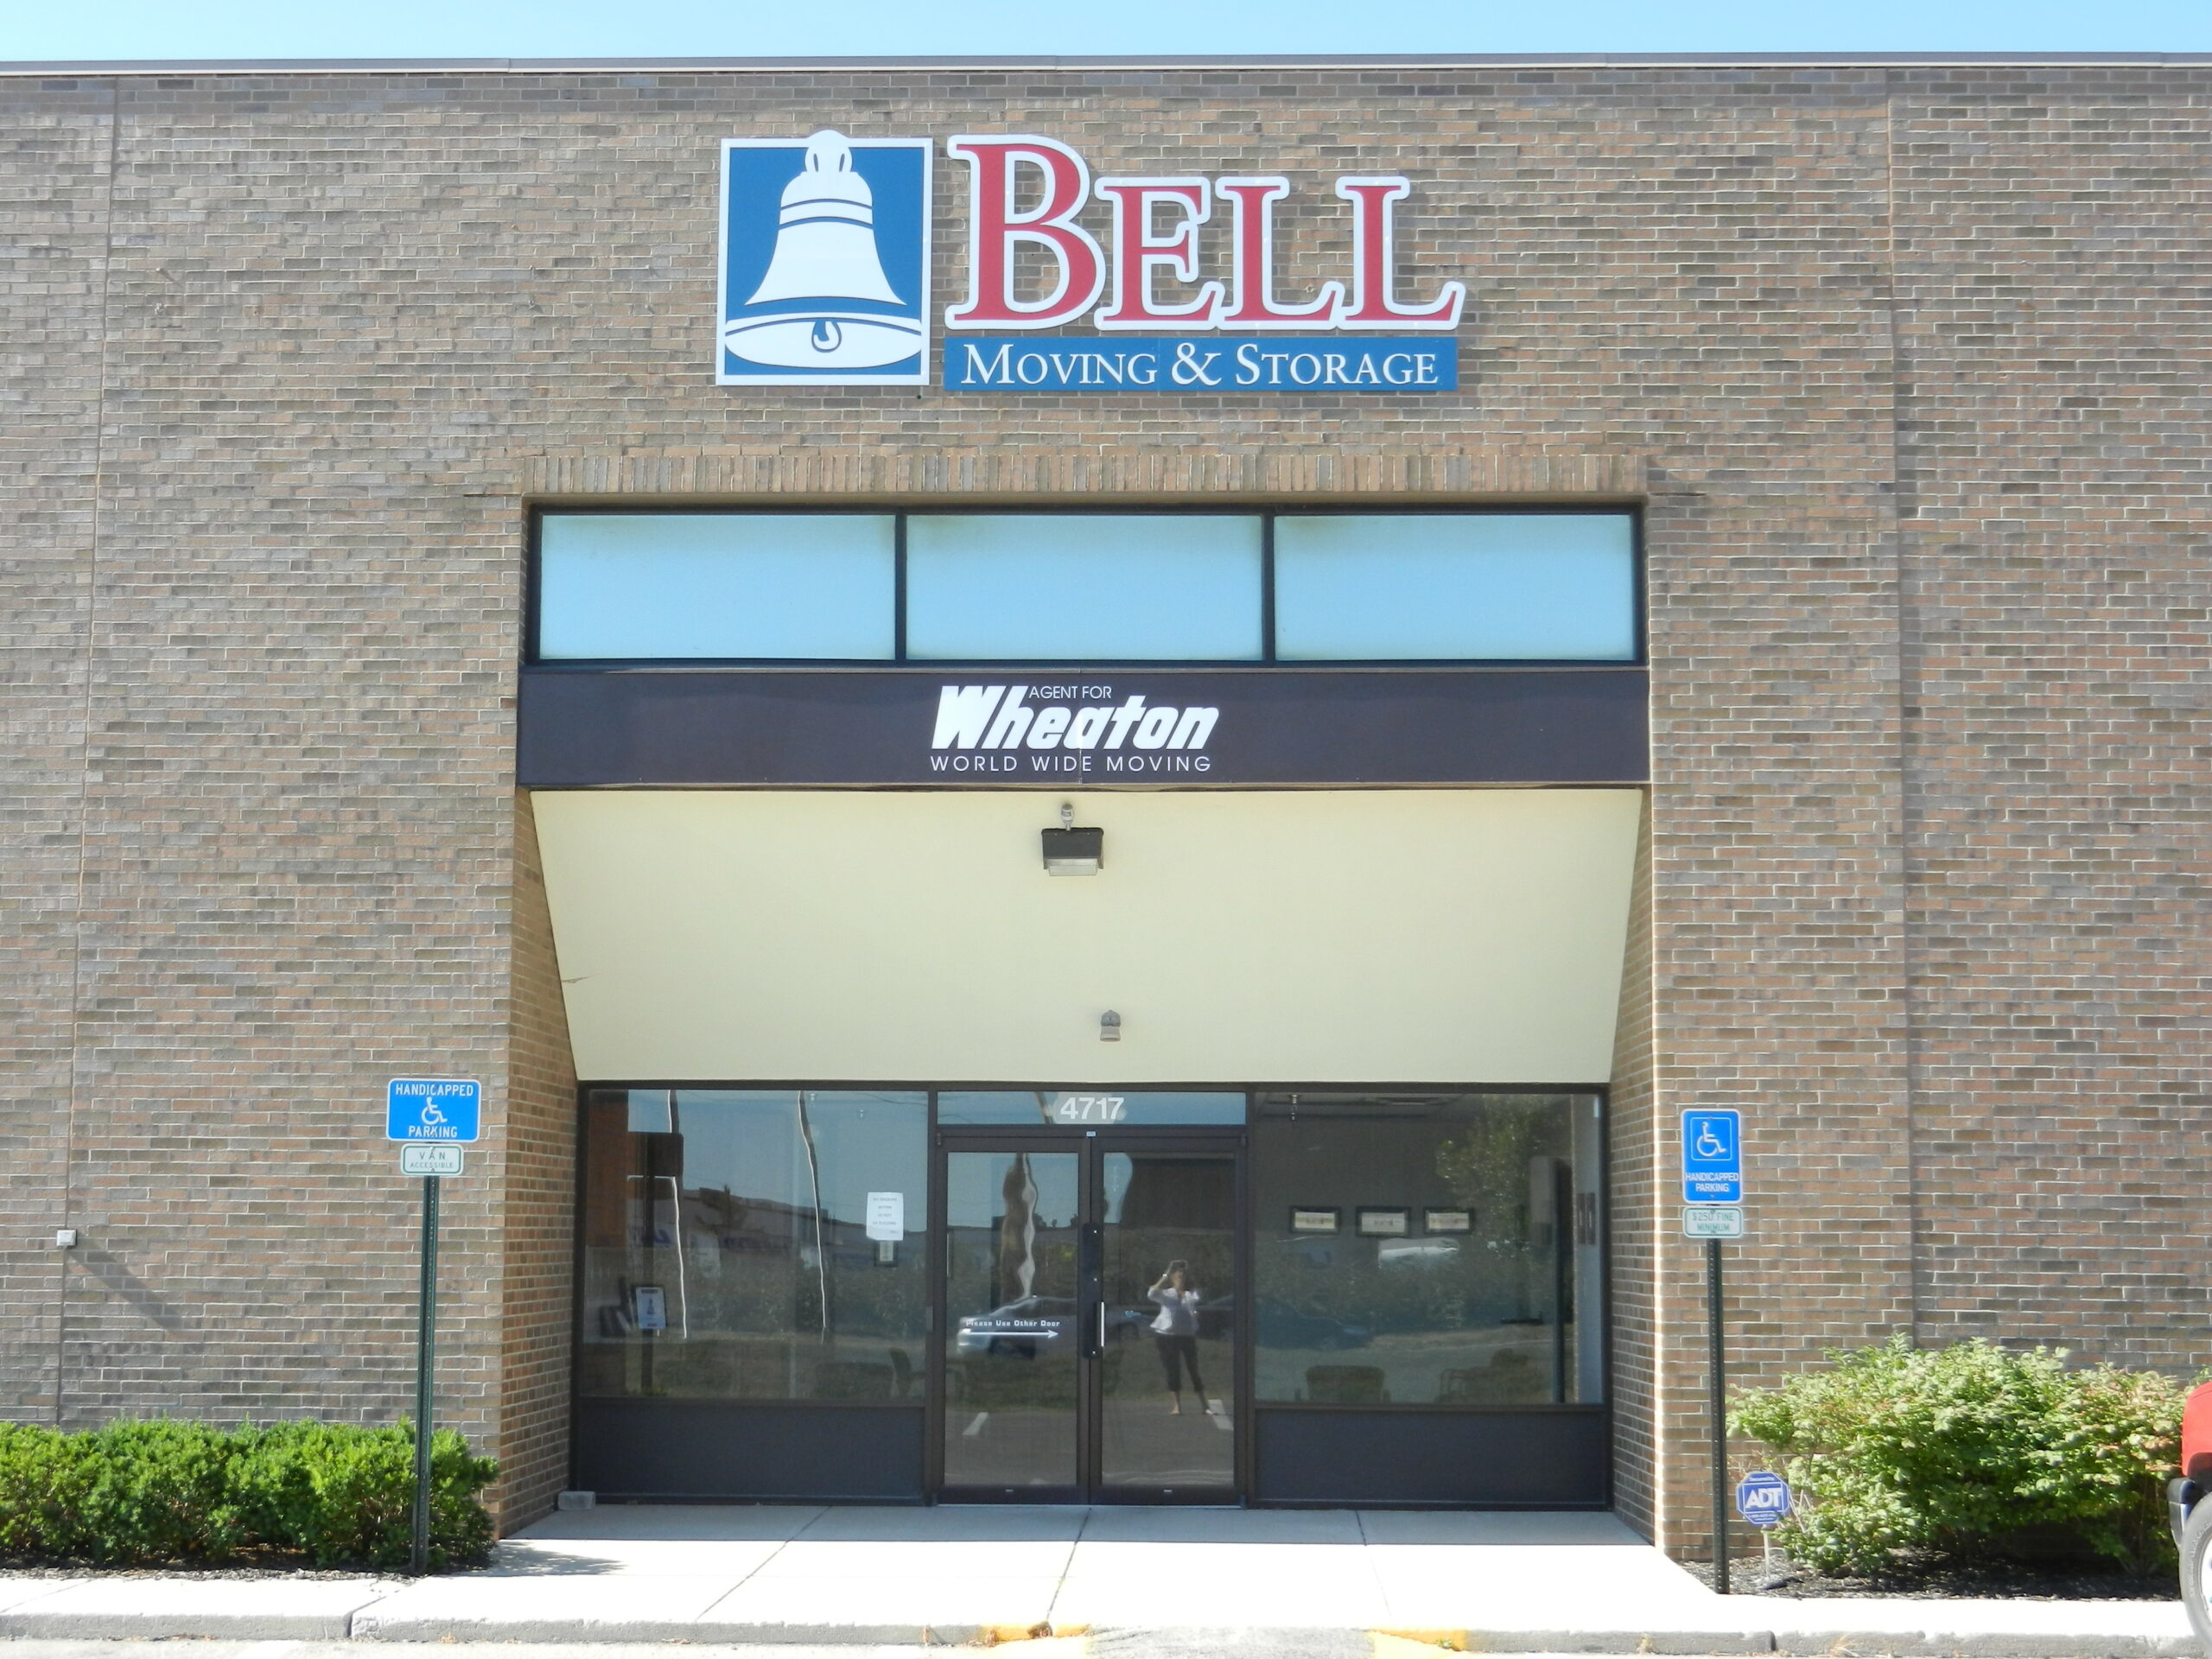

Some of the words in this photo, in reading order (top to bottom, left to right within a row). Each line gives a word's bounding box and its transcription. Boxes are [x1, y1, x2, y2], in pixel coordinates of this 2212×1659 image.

[944, 134, 1465, 330] BELL
[962, 343, 1157, 386] MOVING
[1172, 342, 1222, 386] &
[1236, 343, 1438, 385] STORAGE
[1028, 685, 1077, 699] AGENT
[1082, 685, 1112, 699] FOR
[931, 685, 1220, 750] Wheaton
[930, 756, 1018, 772] WORLD
[1032, 756, 1092, 772] WIDE
[1106, 756, 1211, 772] MOVING
[396, 1084, 474, 1096] HANDICAPPED
[1060, 1096, 1125, 1120] 4717
[408, 1126, 458, 1138] PARKING
[419, 1151, 446, 1160] VAN
[1685, 1172, 1739, 1182] HANDICAPPED
[1695, 1183, 1730, 1192] PARKING
[1716, 1211, 1735, 1222] FINE
[1745, 1487, 1782, 1509] ADT
